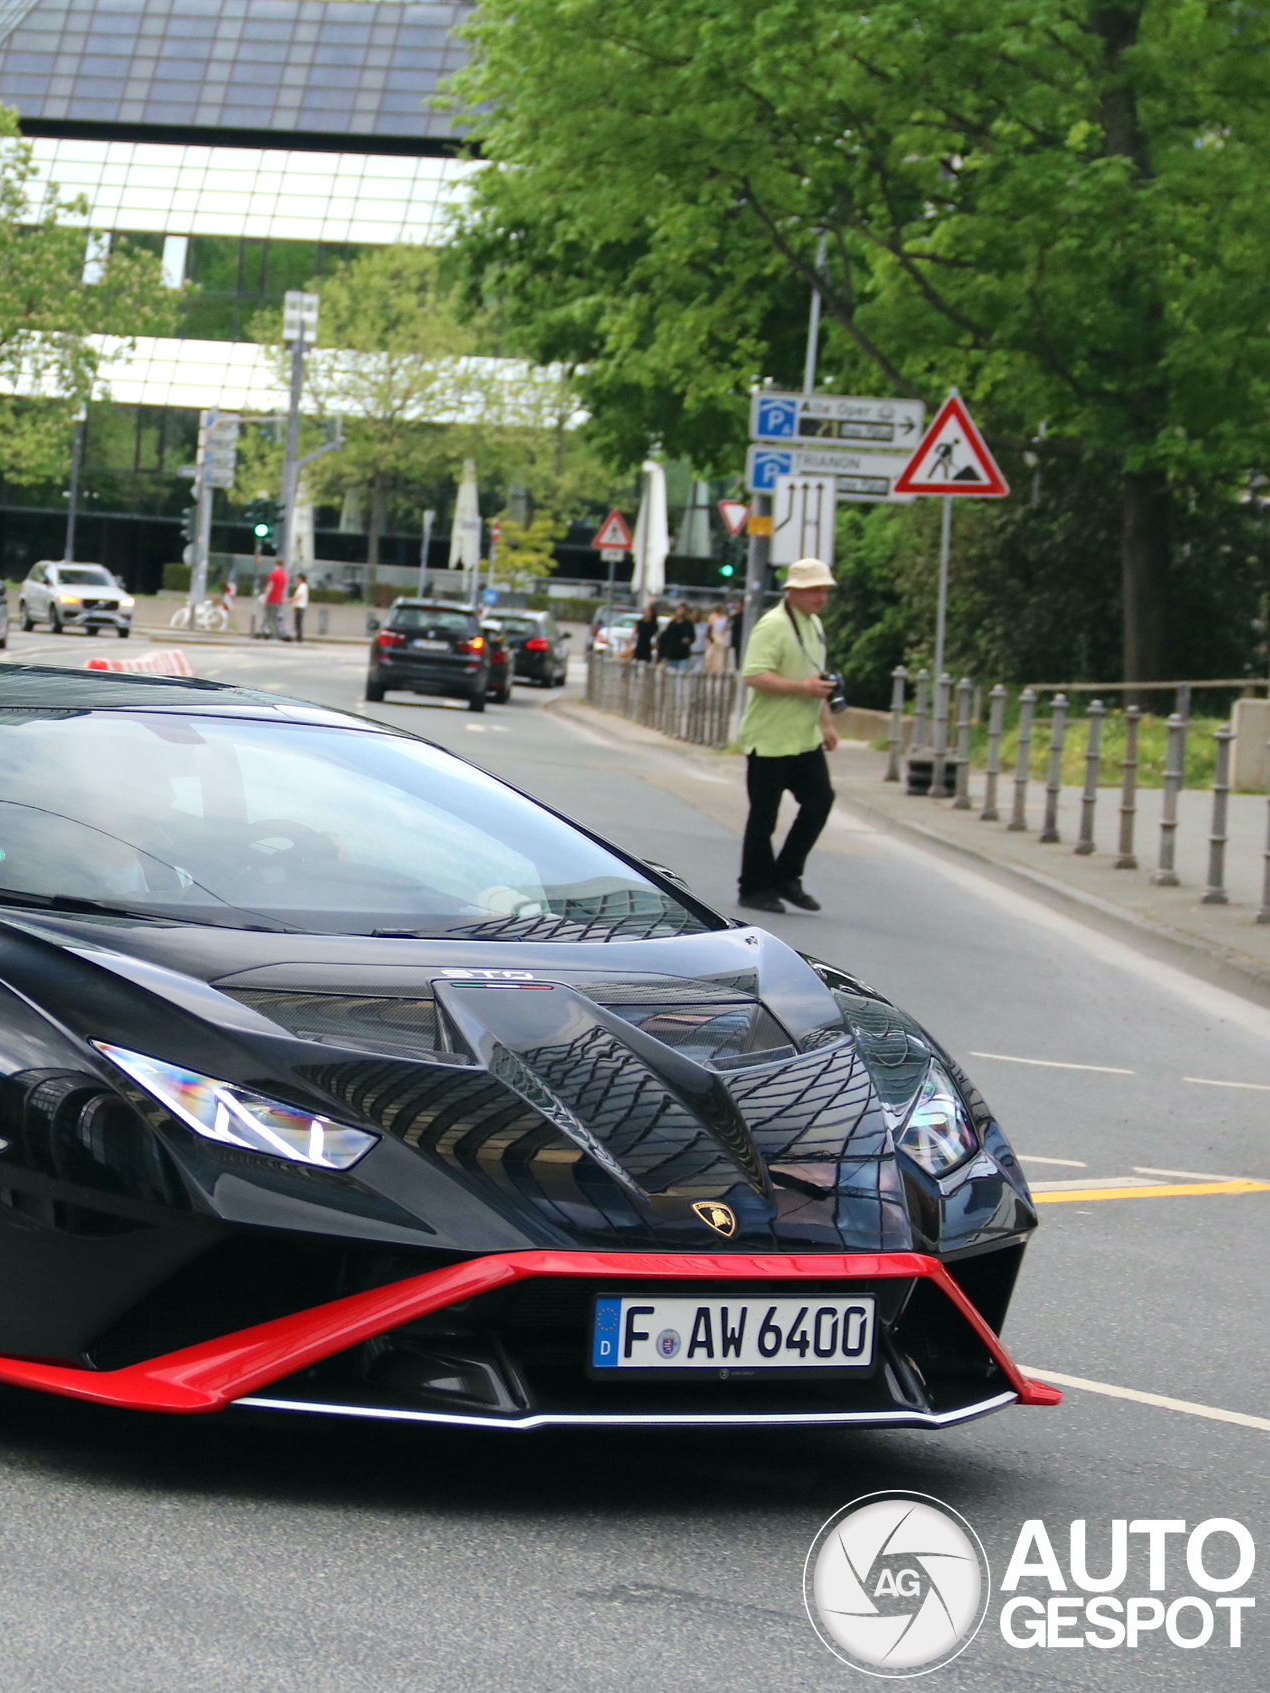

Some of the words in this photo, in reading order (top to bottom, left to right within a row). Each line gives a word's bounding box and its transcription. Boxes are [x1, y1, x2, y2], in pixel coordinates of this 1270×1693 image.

[441, 969, 534, 979] STO
[624, 1306, 655, 1358] F
[687, 1306, 748, 1358] AW
[758, 1306, 868, 1358] 6400
